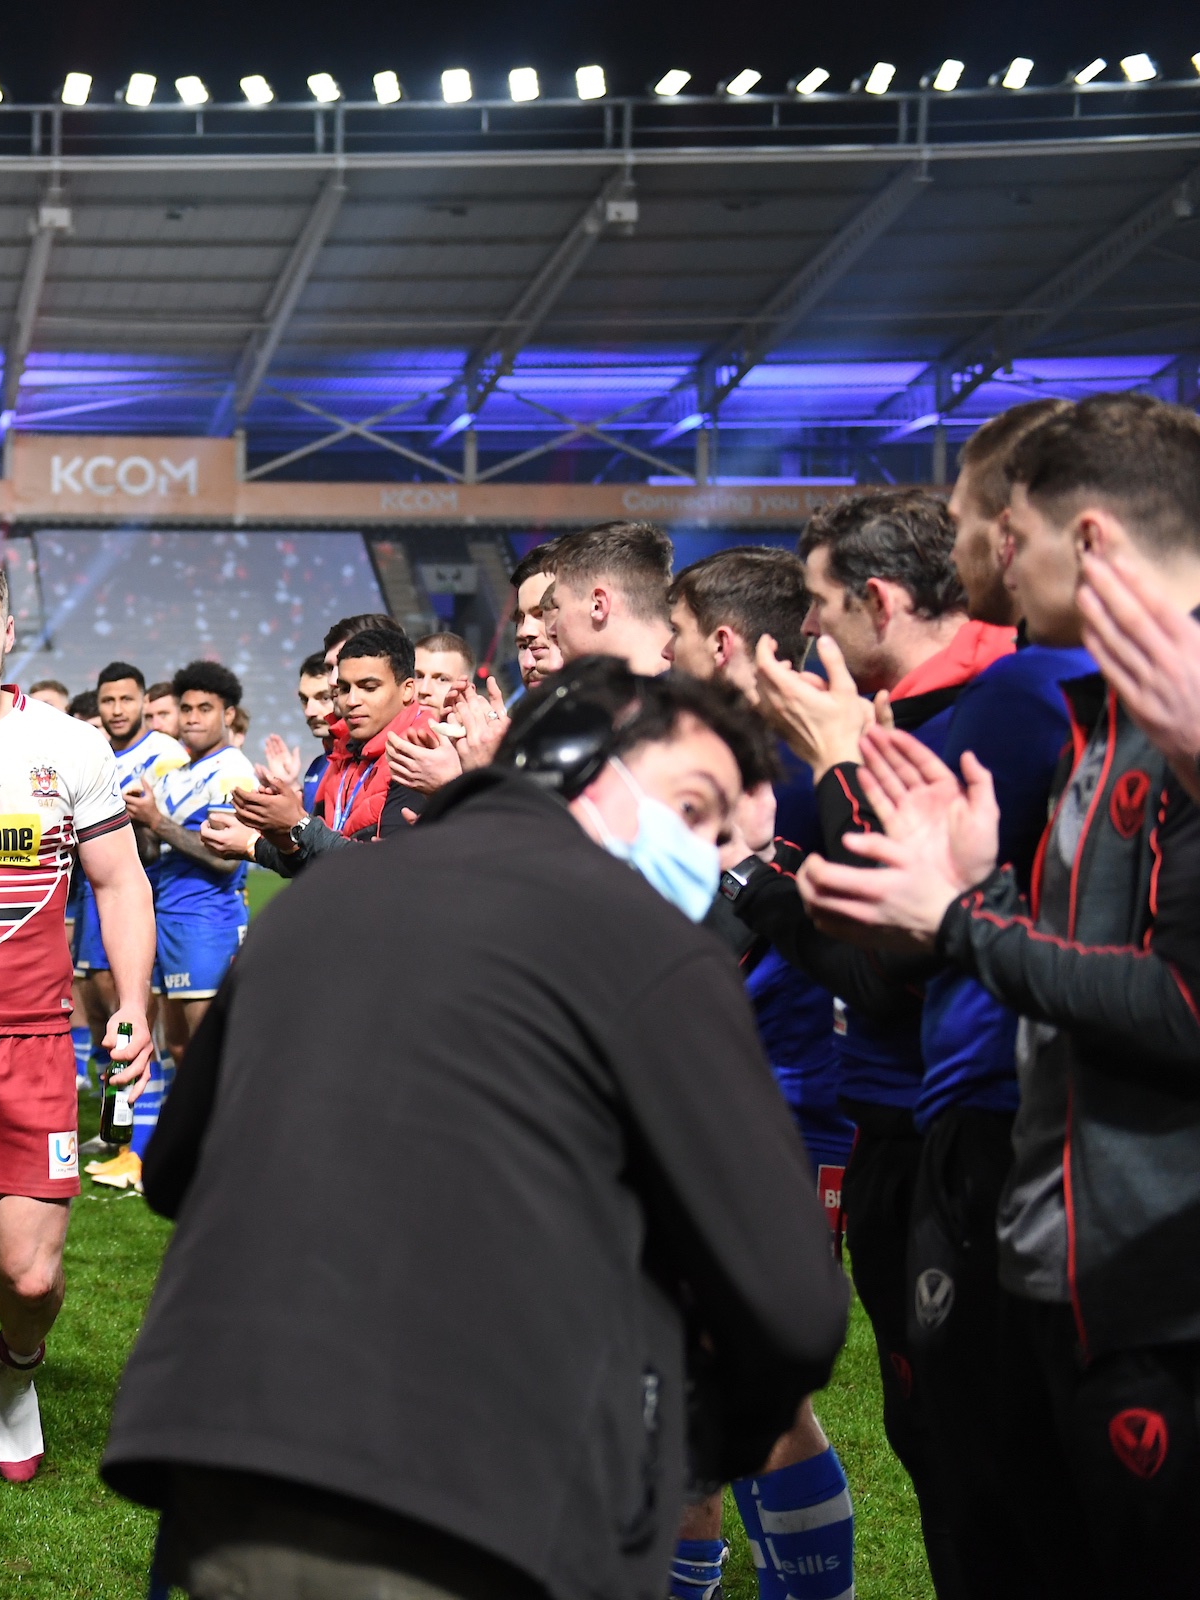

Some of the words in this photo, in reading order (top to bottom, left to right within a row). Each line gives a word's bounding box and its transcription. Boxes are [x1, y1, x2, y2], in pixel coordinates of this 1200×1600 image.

[51, 456, 197, 496] KCOM
[381, 488, 458, 511] KCOM
[622, 490, 752, 514] Connecting
[759, 495, 798, 514] you
[38, 799, 54, 807] 947
